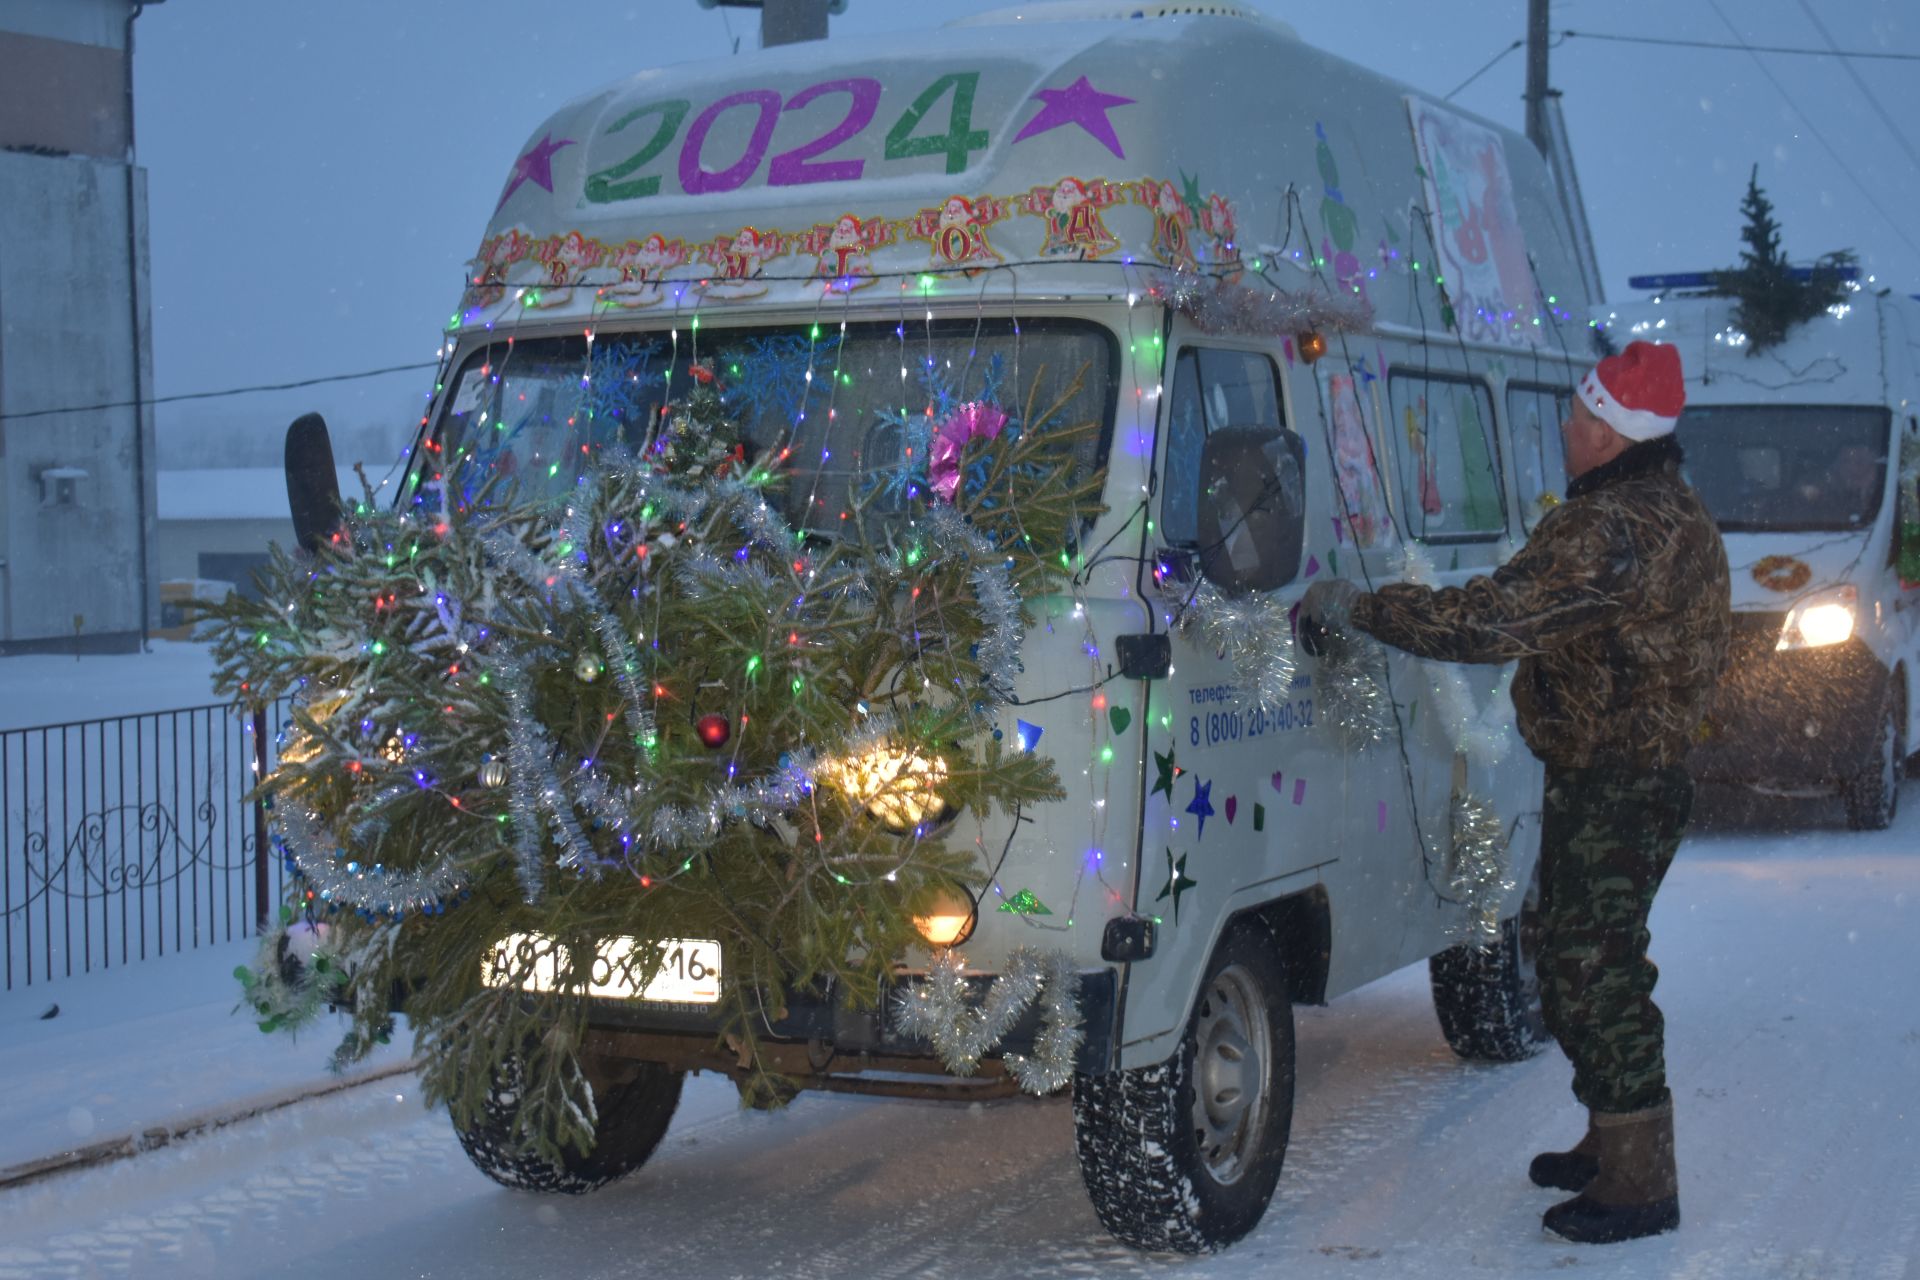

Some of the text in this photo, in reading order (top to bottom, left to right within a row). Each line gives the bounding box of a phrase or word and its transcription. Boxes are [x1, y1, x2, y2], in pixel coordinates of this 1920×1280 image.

[584, 72, 989, 204] 2024
[1189, 684, 1237, 705] телефо
[1190, 716, 1200, 747] 8
[1205, 711, 1243, 747] (800)
